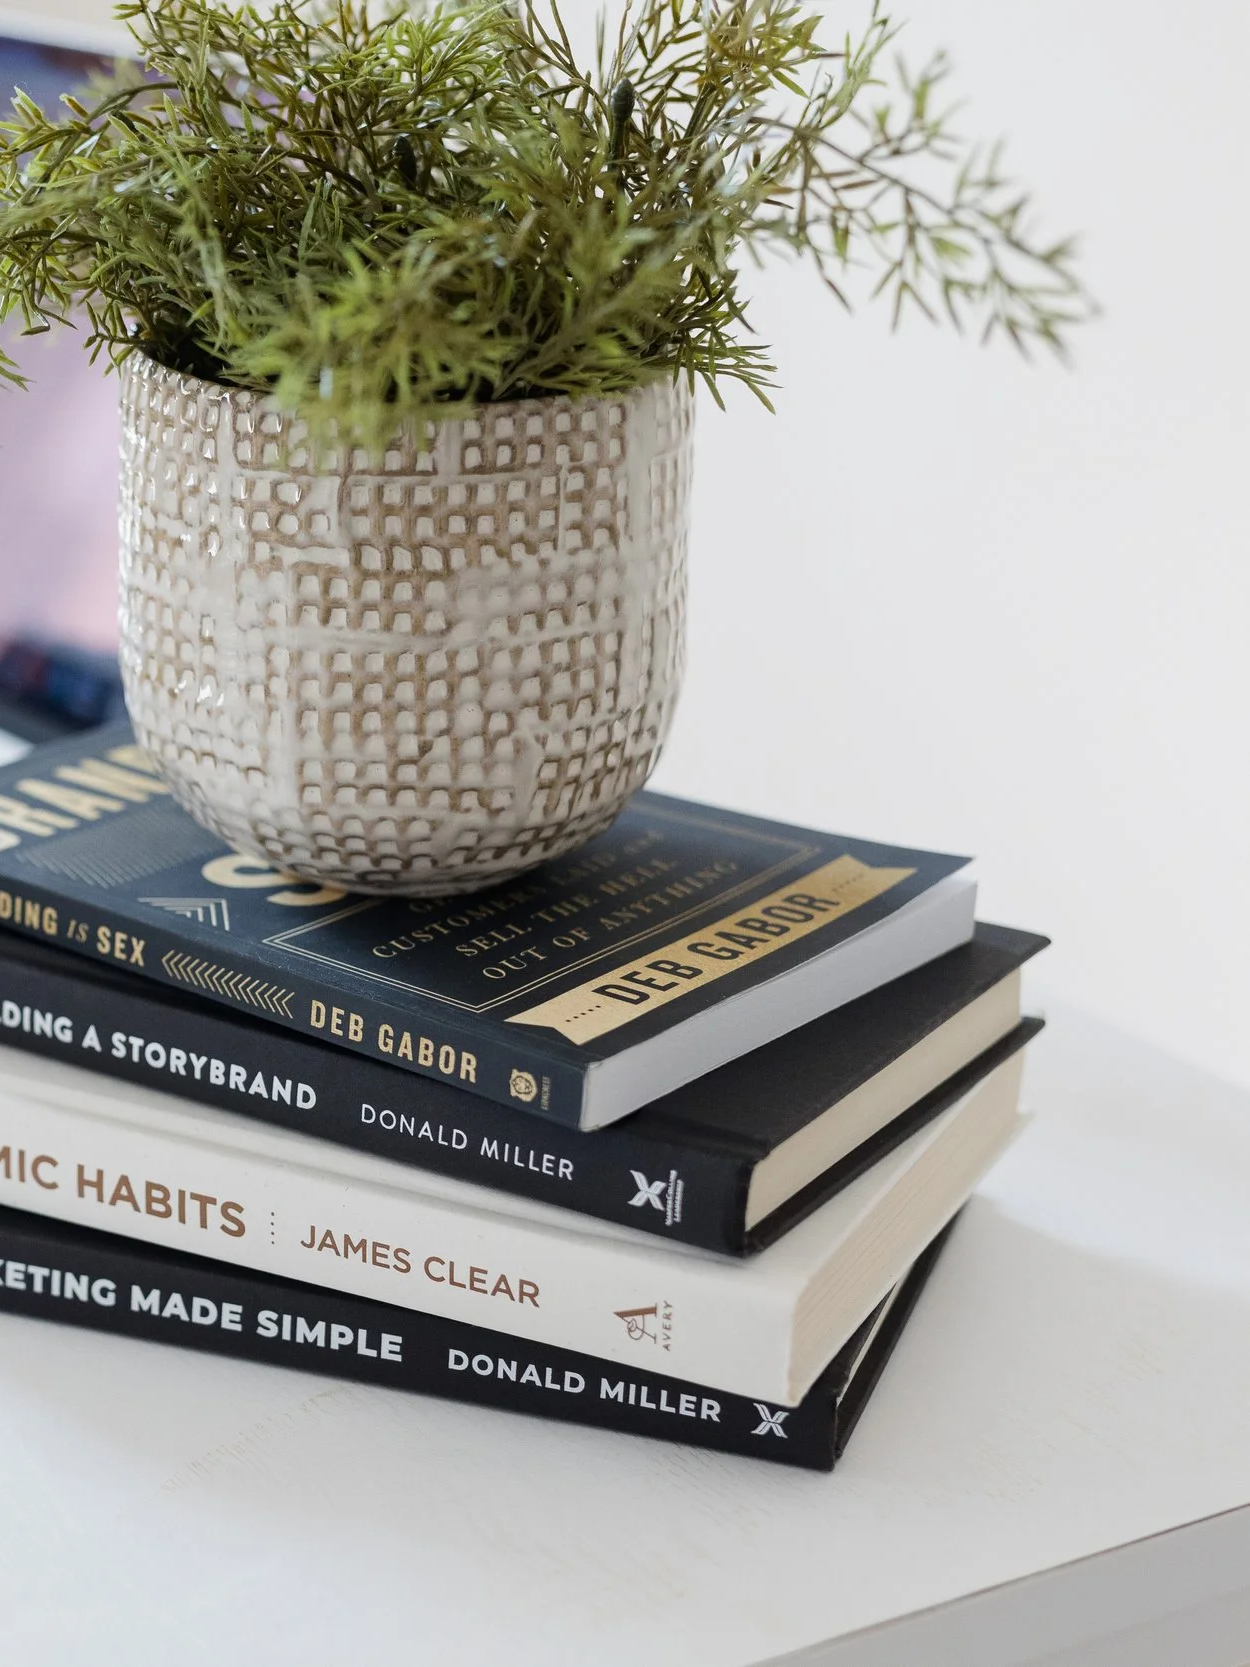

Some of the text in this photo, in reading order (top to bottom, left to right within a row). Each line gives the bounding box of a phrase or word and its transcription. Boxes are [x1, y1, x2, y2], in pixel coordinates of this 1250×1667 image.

[67, 919, 89, 943] IS
[97, 925, 146, 967] SEX
[372, 883, 546, 959] CUSTOMERS
[455, 923, 532, 957] SELL
[530, 893, 599, 923] THE
[482, 860, 738, 980] OUT OF ANYTHING
[591, 893, 841, 1006] DEB GABOR
[82, 1025, 102, 1052] A
[111, 1032, 317, 1110] STORYBRAND
[310, 999, 478, 1083] DEB GABOR
[361, 1103, 575, 1181] DONALD MILLER
[77, 1164, 247, 1238] HABITS
[300, 1224, 541, 1308] JAMES CLEAR
[130, 1285, 243, 1332] MADE
[256, 1309, 403, 1362] SIMPLE
[661, 1299, 673, 1352] AVERY
[448, 1349, 722, 1423] DONALD MILLER
